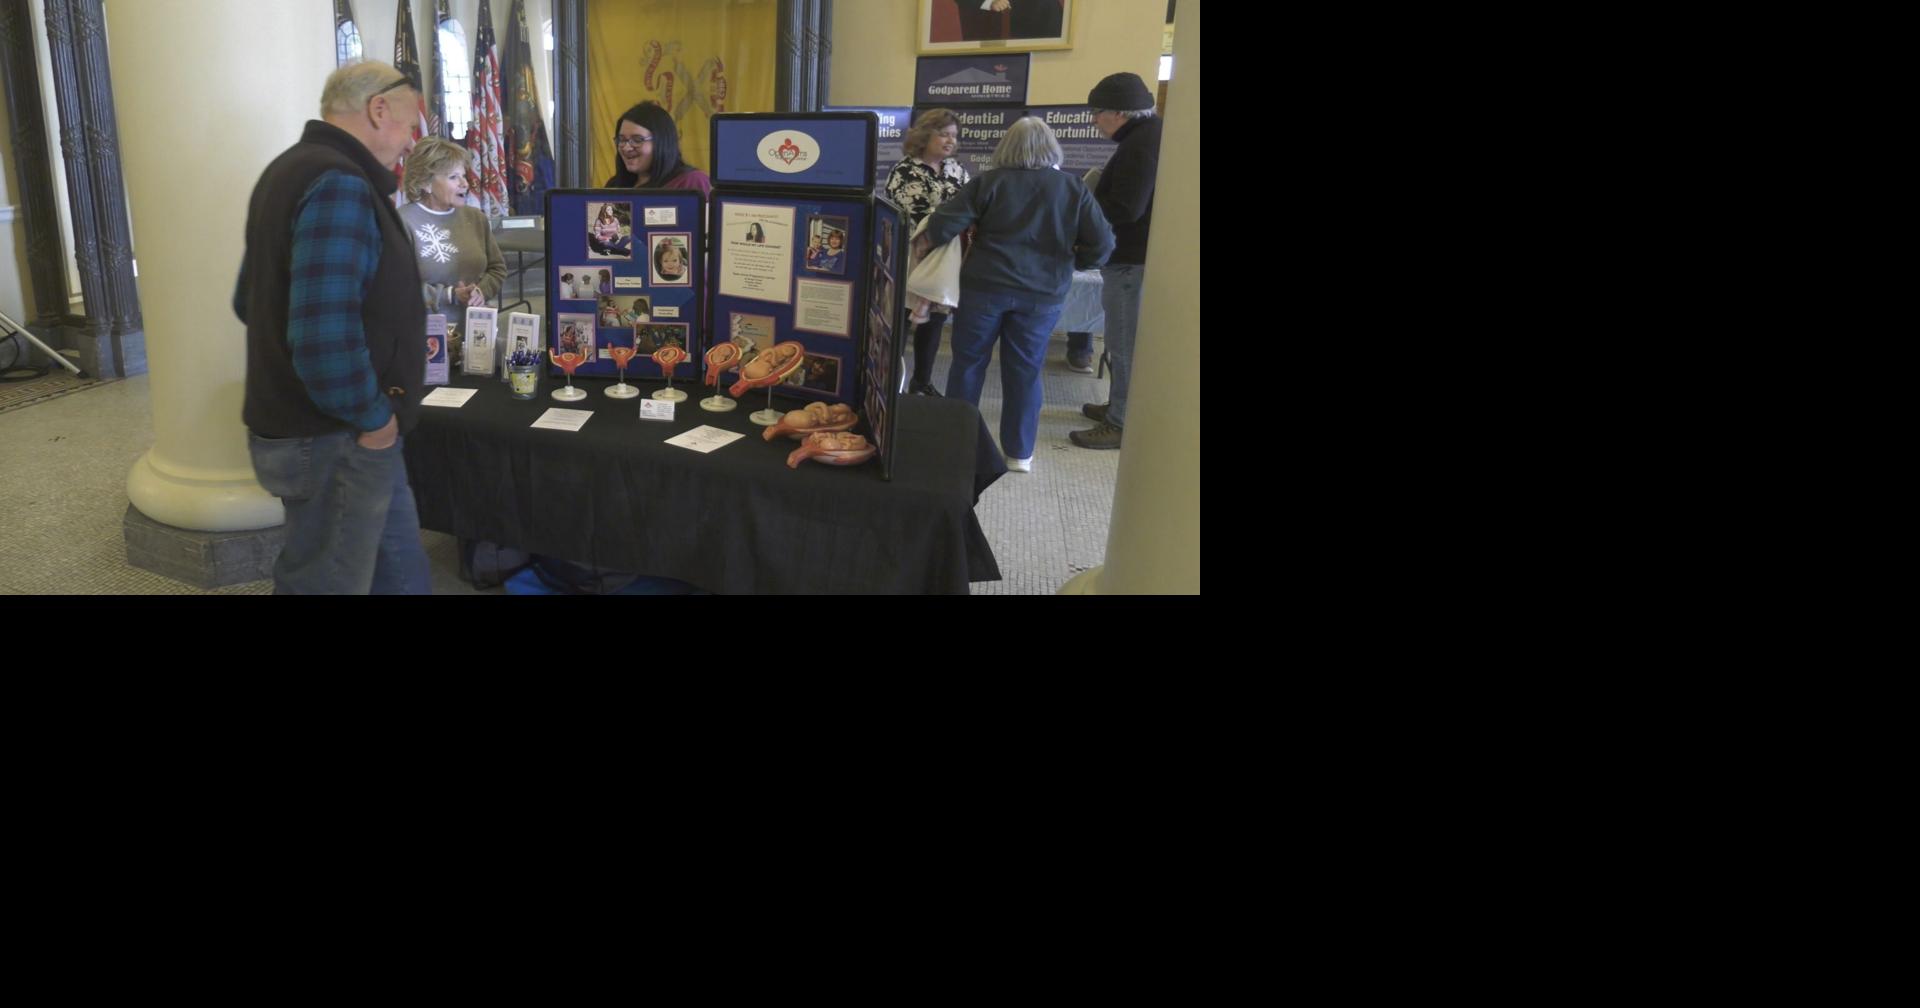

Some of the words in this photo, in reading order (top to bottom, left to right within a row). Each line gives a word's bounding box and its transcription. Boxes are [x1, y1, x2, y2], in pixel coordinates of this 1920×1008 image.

[928, 85, 979, 96] Godparent
[982, 84, 1012, 94] Home
[879, 113, 895, 126] ing
[957, 112, 1004, 125] dential
[879, 127, 901, 138] ities
[1051, 125, 1103, 138] ortuniti
